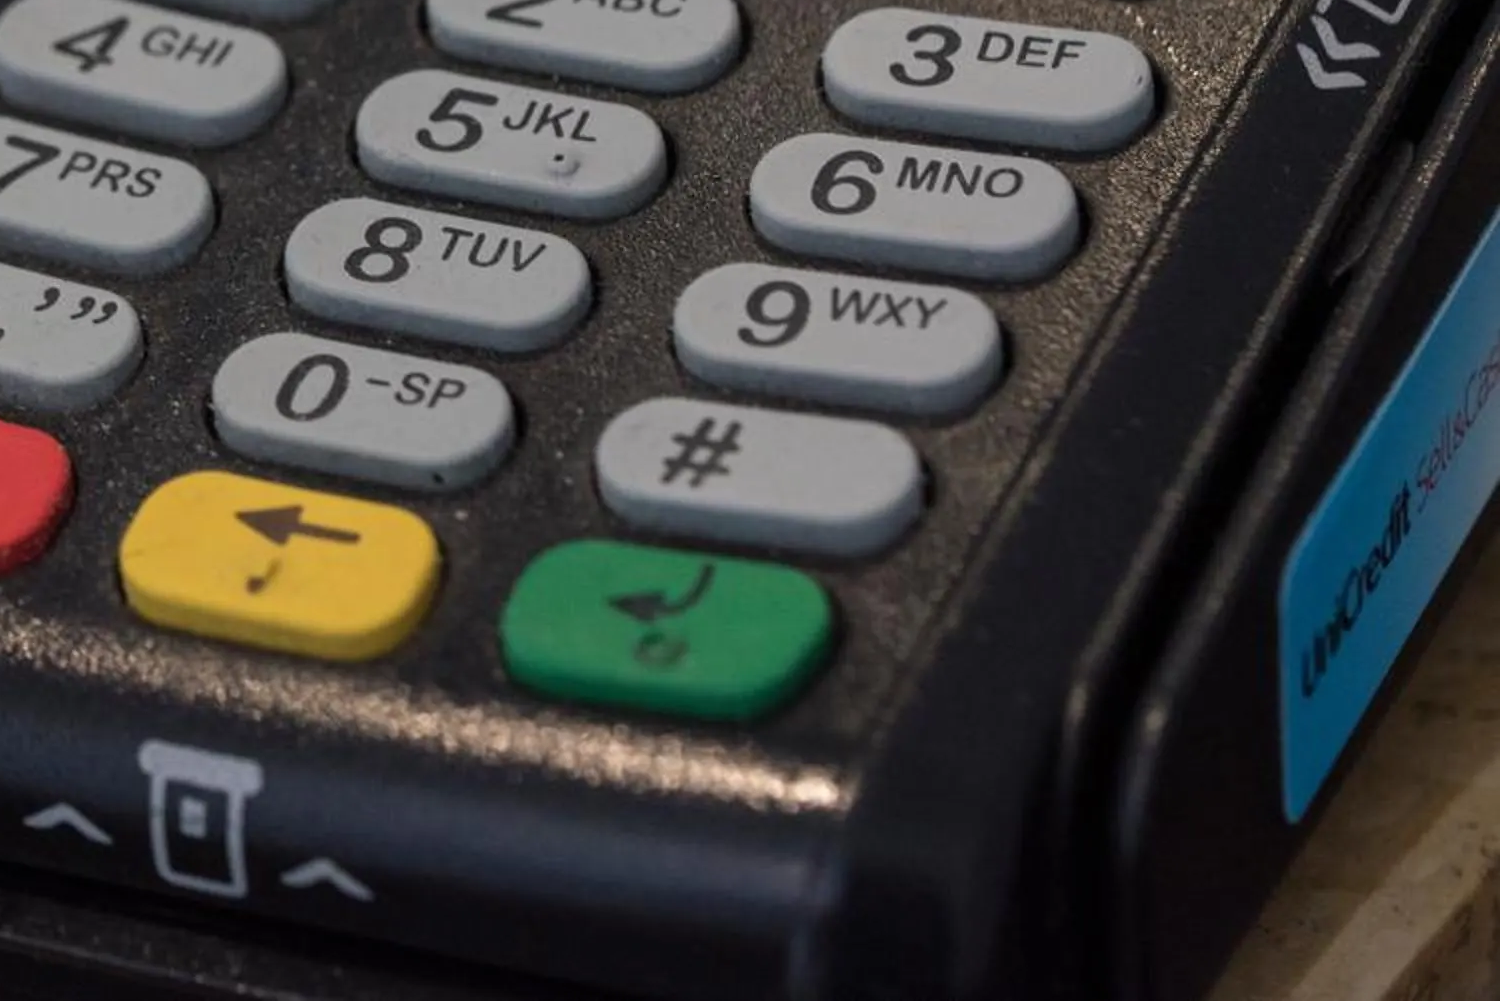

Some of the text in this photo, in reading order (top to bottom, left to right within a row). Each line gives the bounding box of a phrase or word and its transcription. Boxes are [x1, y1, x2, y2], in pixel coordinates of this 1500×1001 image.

[52, 16, 234, 73] 4 GHI
[889, 25, 1087, 87] 3 DEF
[416, 88, 598, 153] 5 JKL
[59, 151, 163, 198] PRS
[810, 150, 1025, 215] 6 MNO
[344, 217, 547, 283] 8 TUV
[738, 280, 948, 348] 9 WXY
[275, 354, 350, 421] 0
[660, 416, 743, 489] #
[1303, 478, 1411, 698] UniCredit
